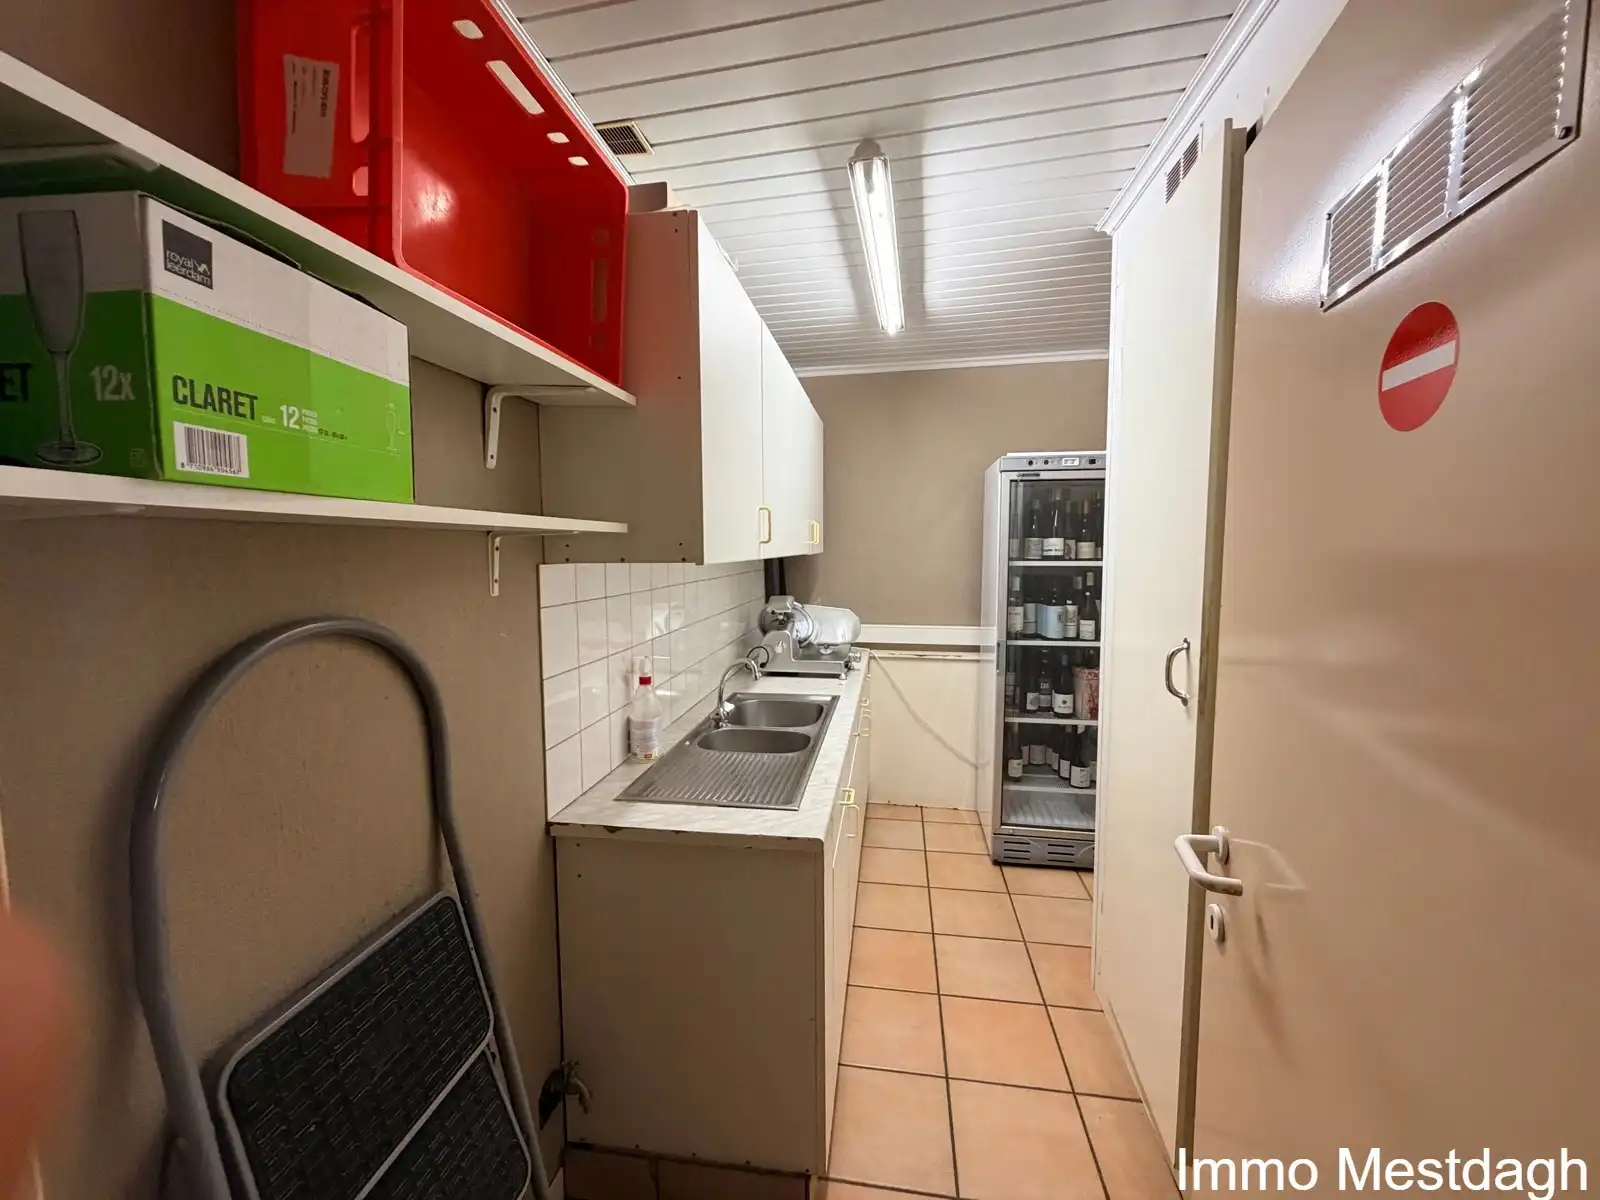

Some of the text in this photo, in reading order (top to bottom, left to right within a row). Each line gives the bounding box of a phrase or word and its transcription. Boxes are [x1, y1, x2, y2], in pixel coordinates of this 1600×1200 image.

[166, 249, 193, 269] royal
[166, 258, 211, 287] leerdam
[172, 374, 258, 420] CLARET
[280, 404, 300, 430] 12
